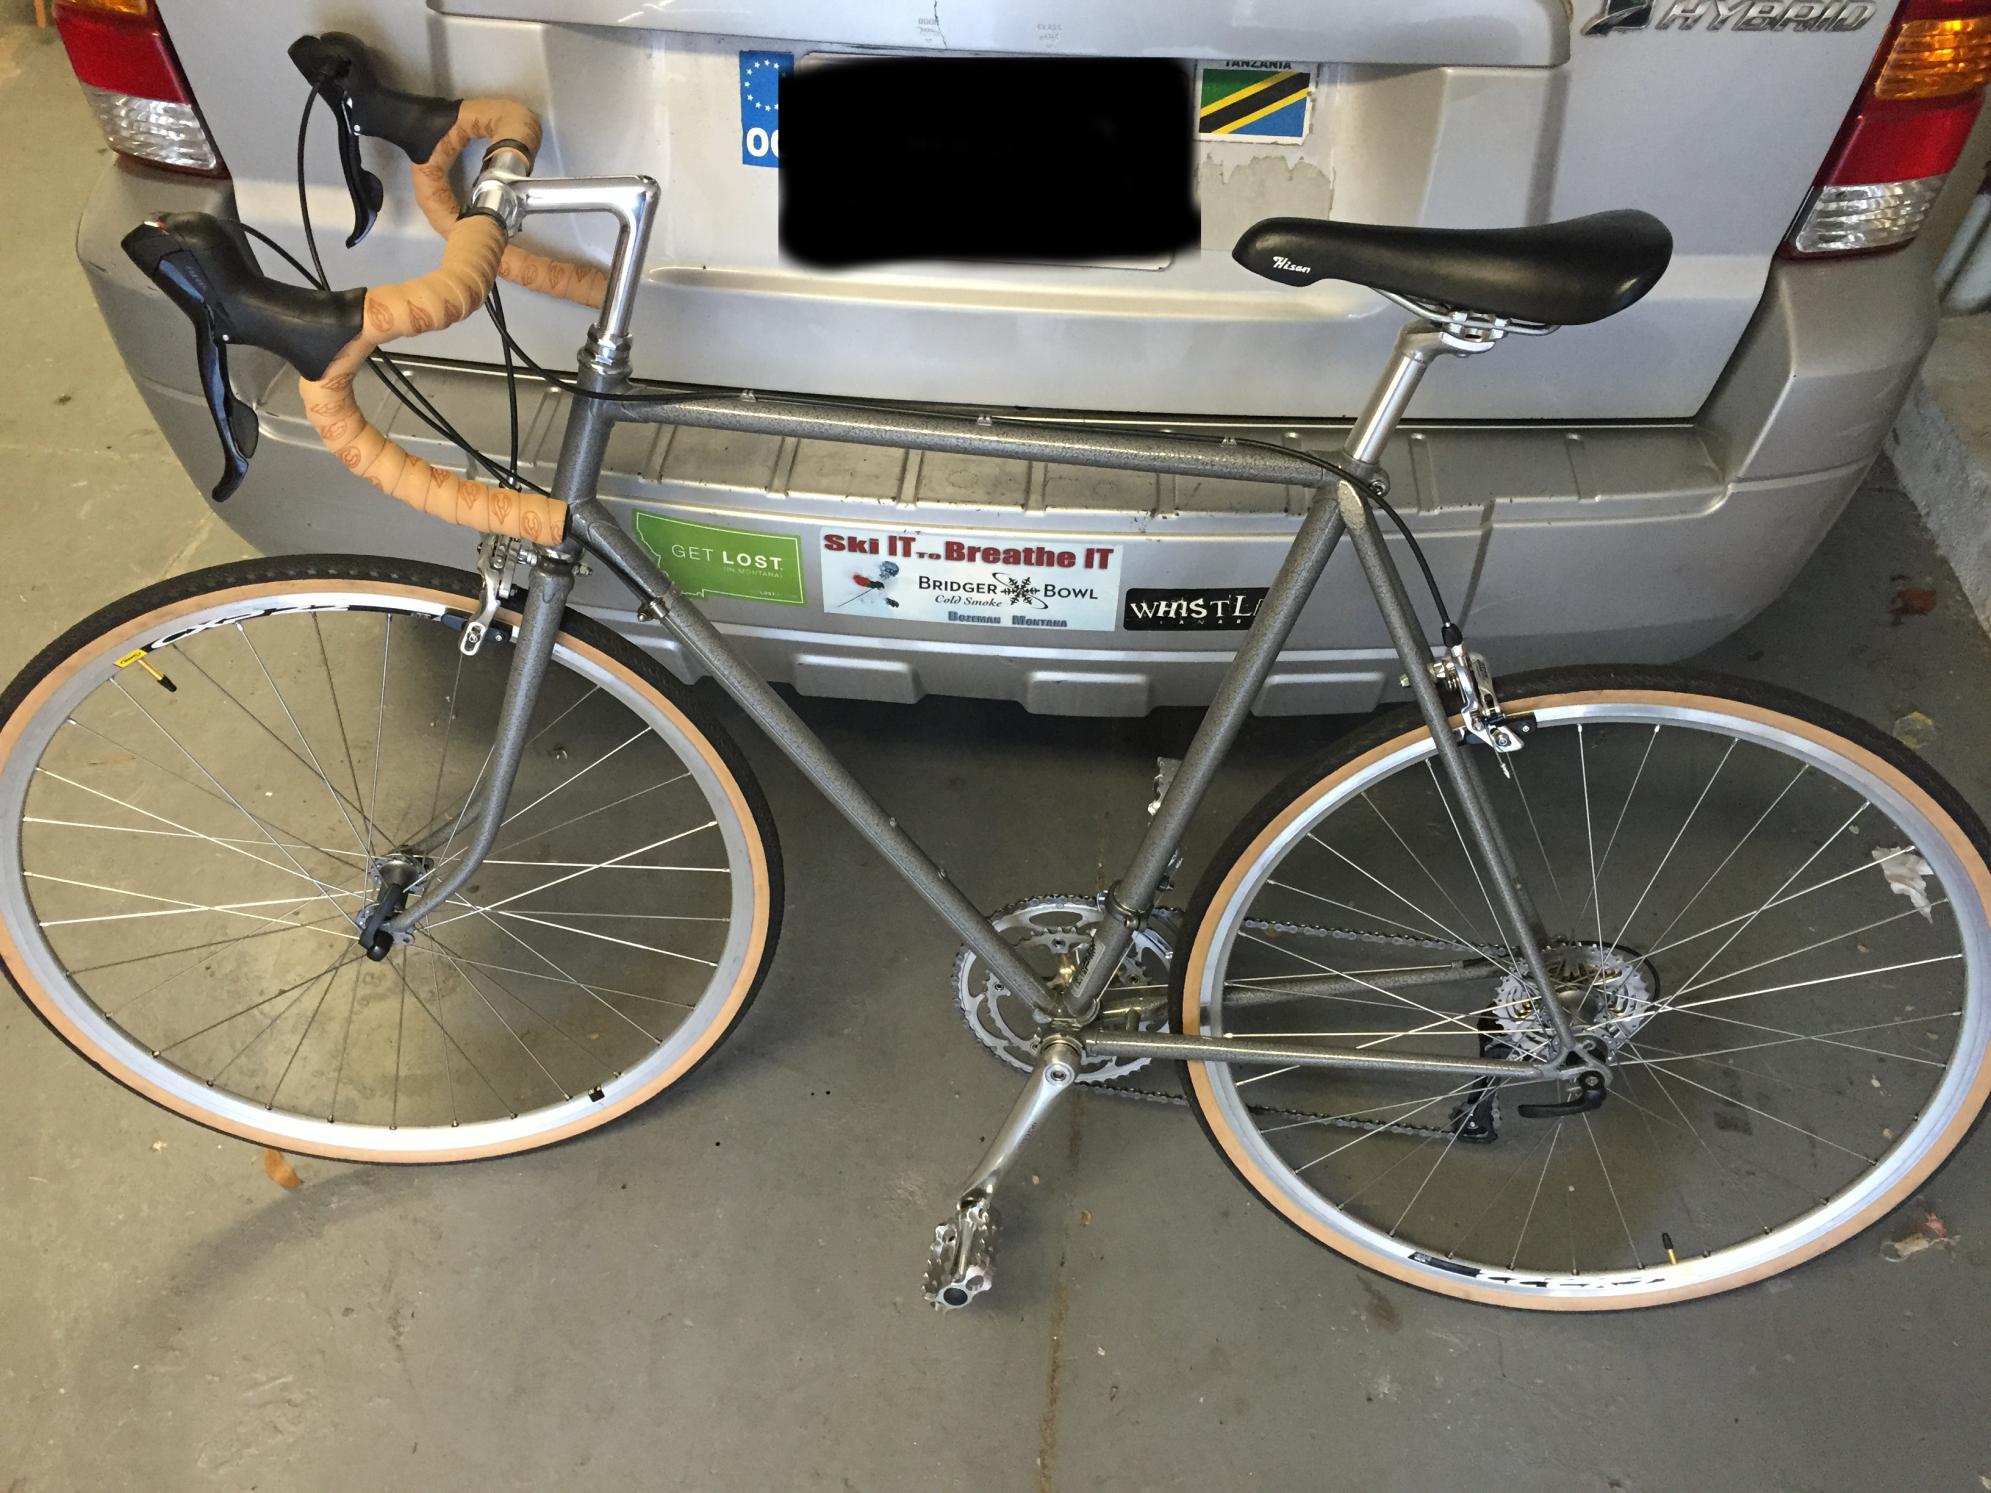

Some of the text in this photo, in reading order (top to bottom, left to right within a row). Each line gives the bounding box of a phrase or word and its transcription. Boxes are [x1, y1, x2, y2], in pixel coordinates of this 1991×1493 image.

[1655, 0, 1877, 32] HYBRID
[1225, 60, 1292, 69] TANZANIA
[671, 544, 714, 561] GET
[823, 533, 879, 555] Ski
[888, 535, 916, 557] IT
[944, 540, 1076, 569] Breathe
[1084, 547, 1114, 570] IT
[917, 575, 1099, 600] BRIDGER BOWL
[934, 594, 1003, 608] Cold Smoke
